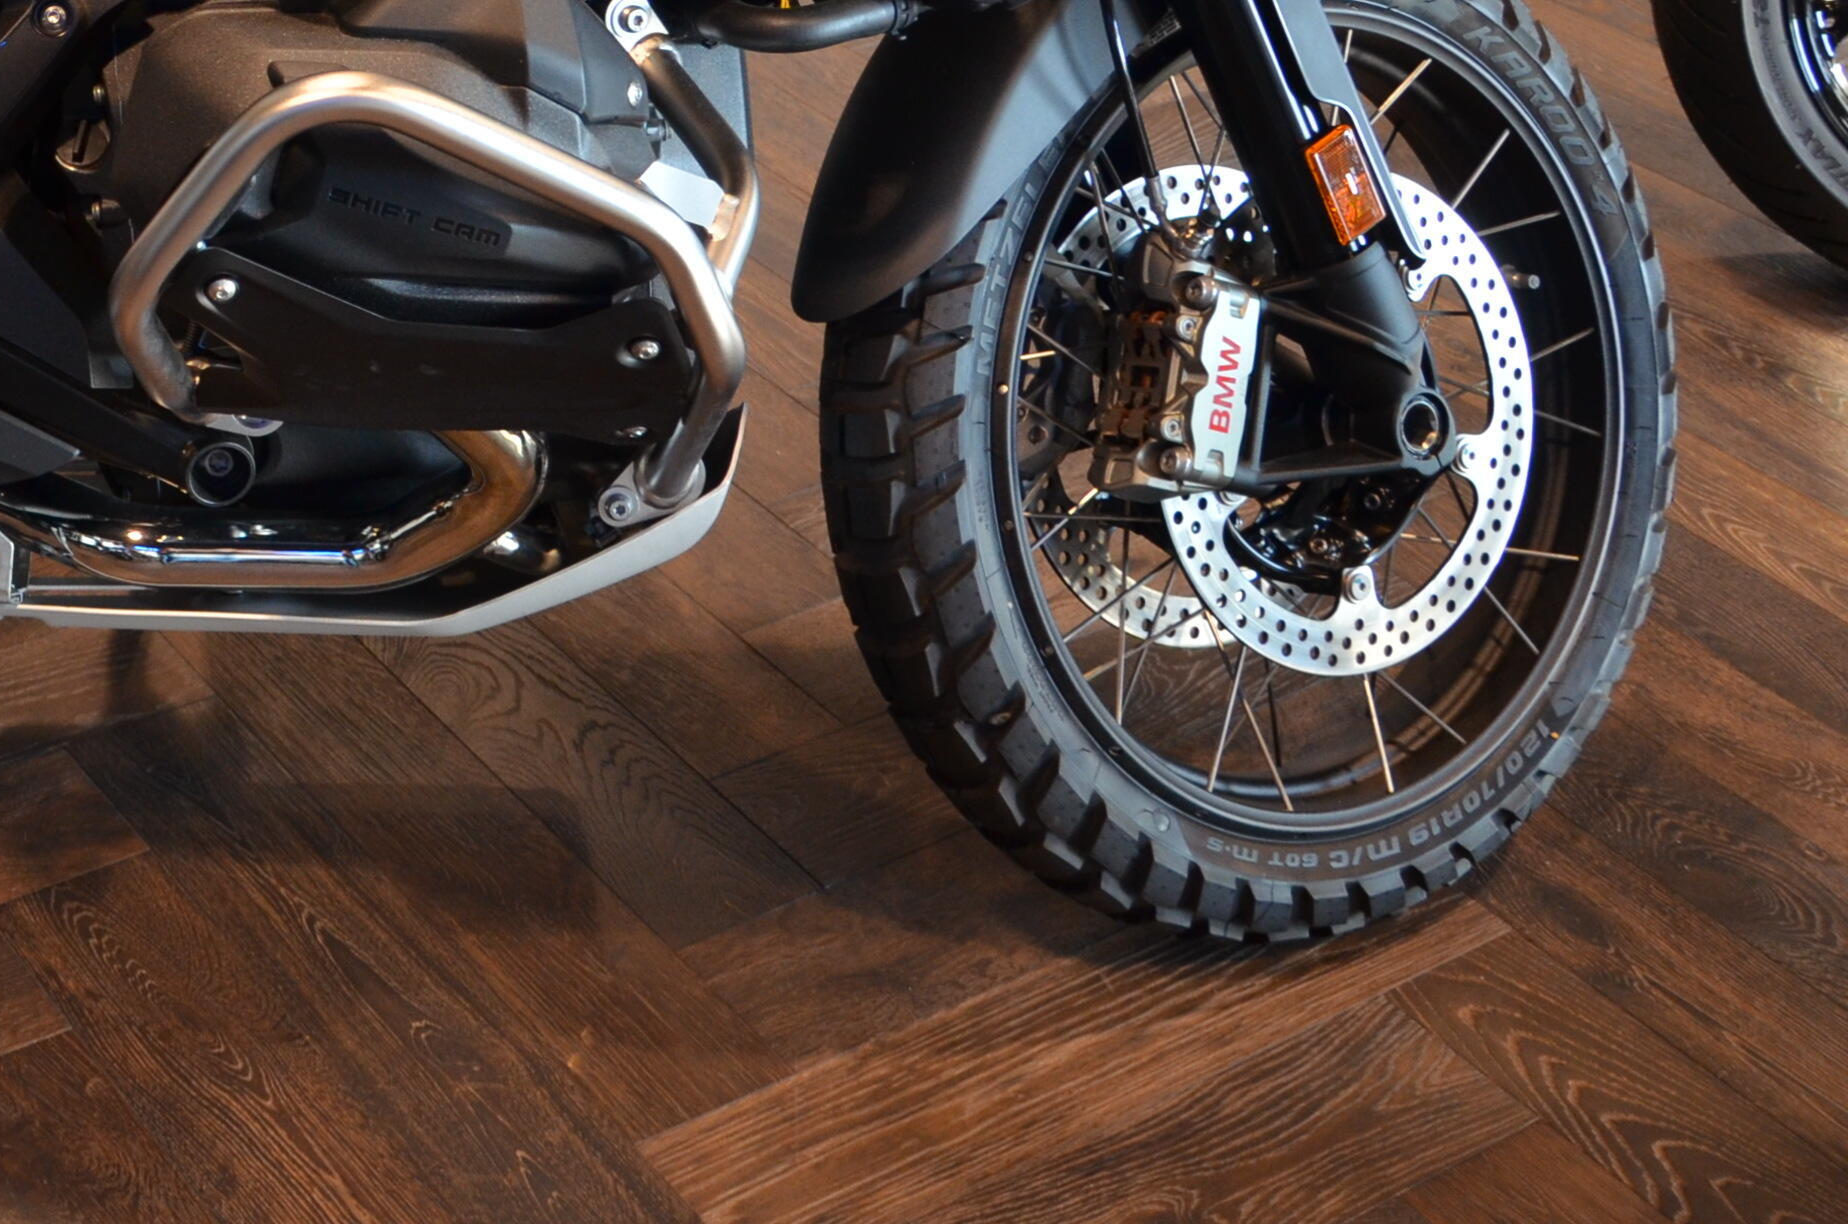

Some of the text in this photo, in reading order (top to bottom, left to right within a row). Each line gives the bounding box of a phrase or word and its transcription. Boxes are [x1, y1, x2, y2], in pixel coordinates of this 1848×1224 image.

[1463, 26, 1618, 216] KAROO 4
[328, 186, 501, 247] SHIFT CAM
[1208, 336, 1241, 434] BMW
[1408, 722, 1550, 846] 120/70R19
[1268, 850, 1319, 869] 60T
[1329, 836, 1401, 869] M/C
